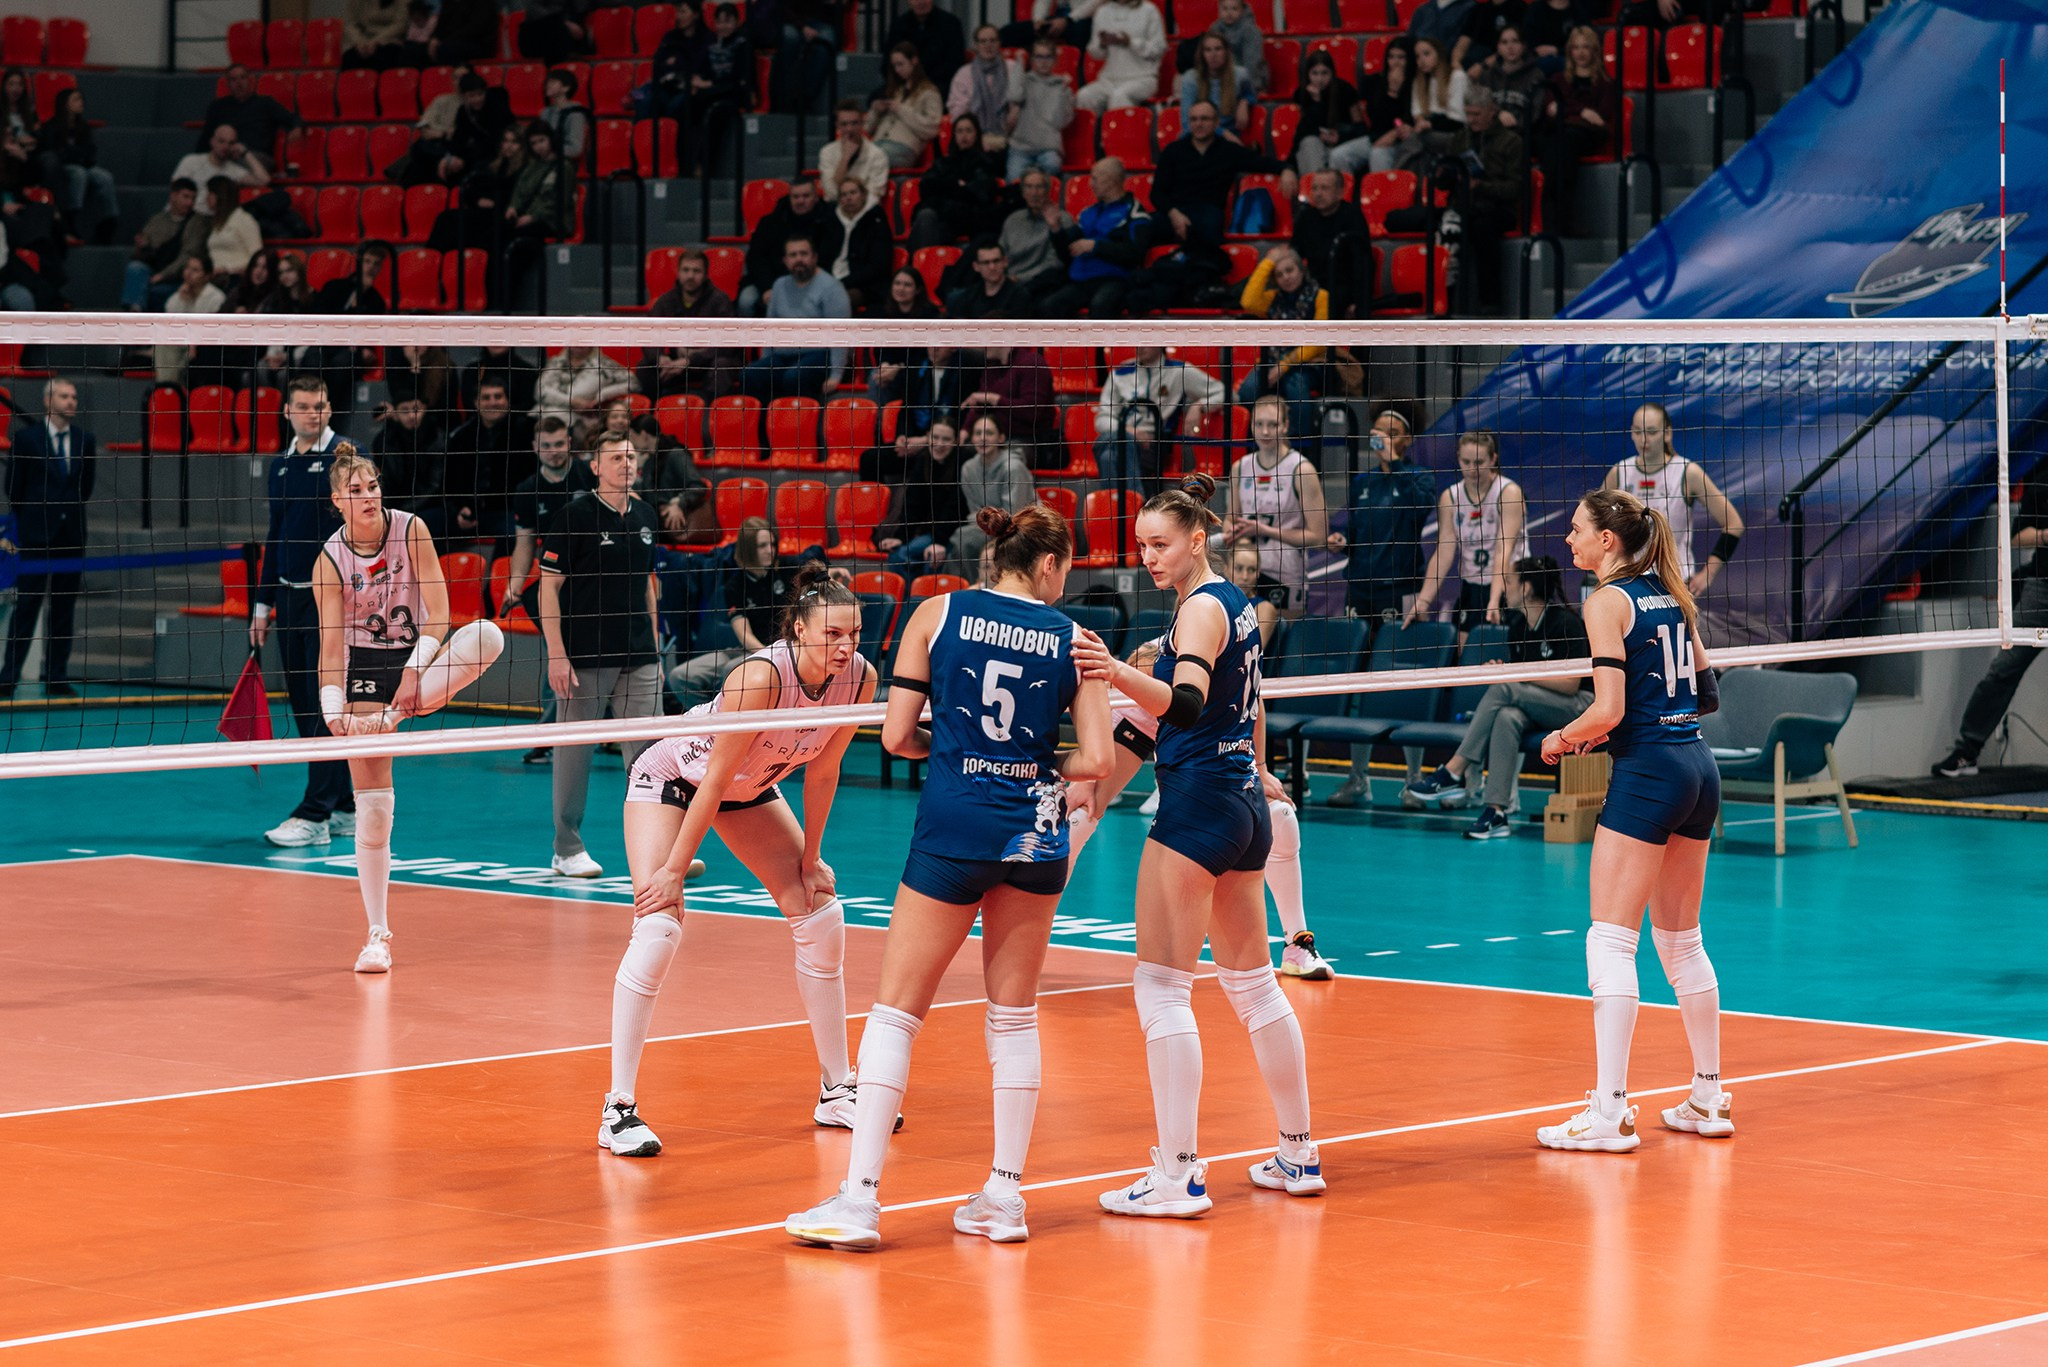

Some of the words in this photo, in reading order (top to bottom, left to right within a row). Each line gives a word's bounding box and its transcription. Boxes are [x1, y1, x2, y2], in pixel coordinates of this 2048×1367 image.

[1668, 367, 1937, 390] УНИВЕРСИТЕ
[364, 604, 421, 647] 23
[959, 615, 1060, 659] ИВАНОВИЧ
[1656, 622, 1698, 698] 14
[351, 679, 377, 694] 23
[981, 659, 1024, 742] 5
